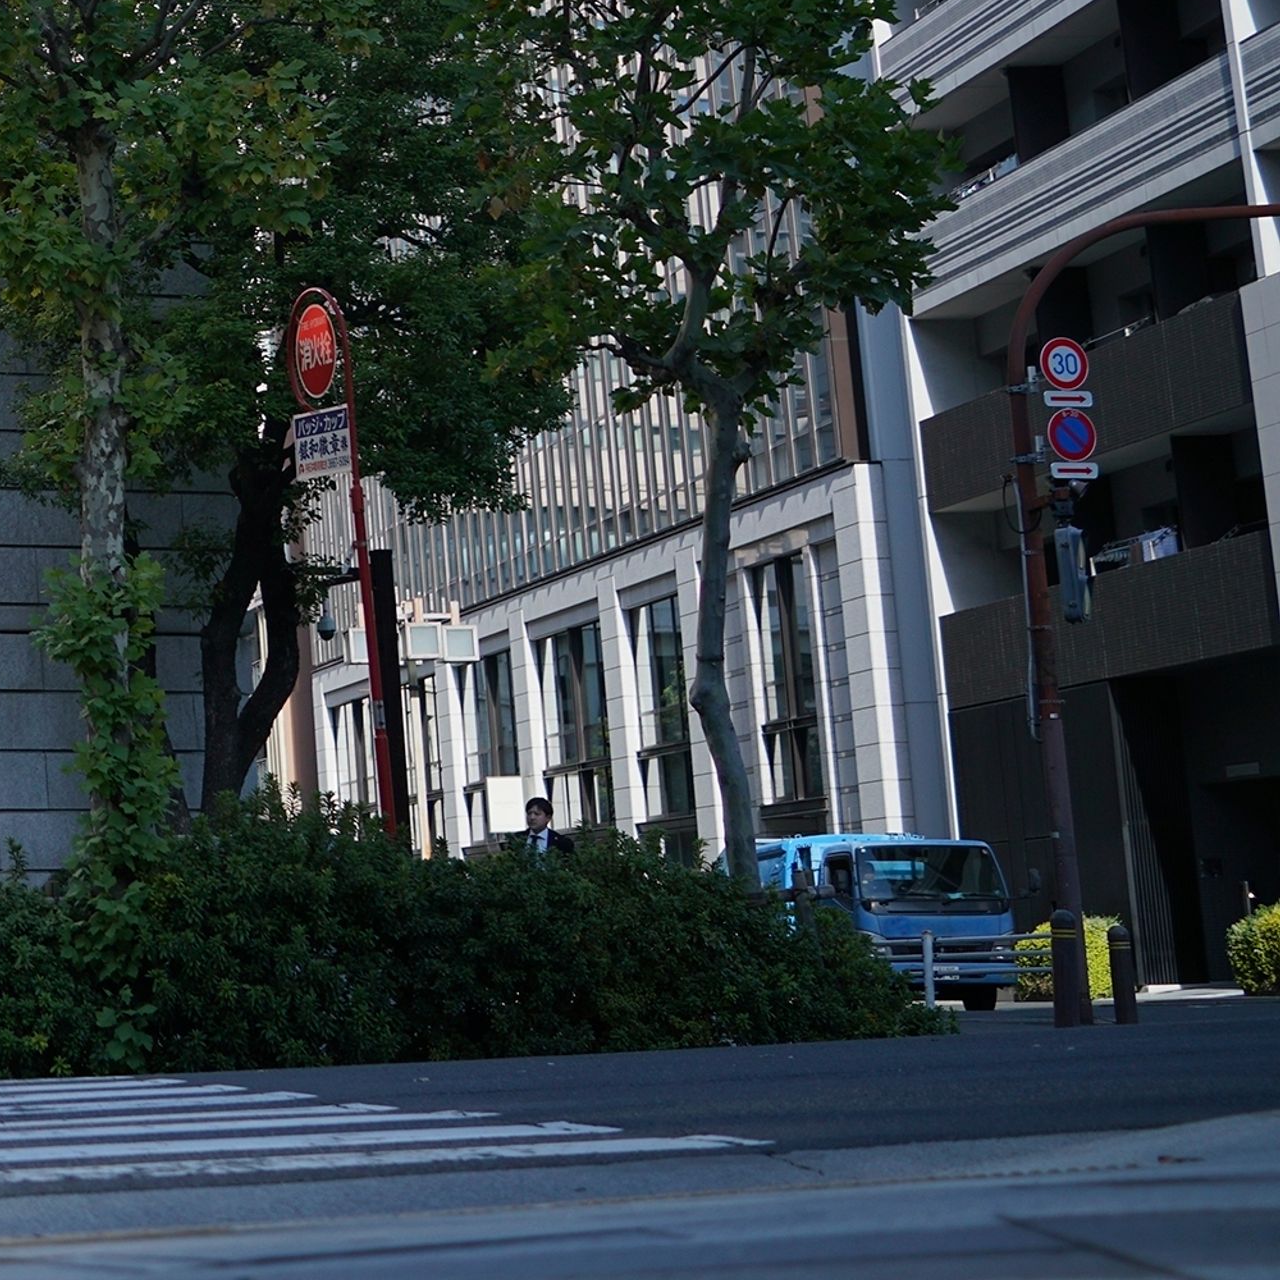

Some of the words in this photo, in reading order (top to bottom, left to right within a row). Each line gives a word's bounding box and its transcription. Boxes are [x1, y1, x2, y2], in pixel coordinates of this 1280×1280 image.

[299, 330, 333, 373] 消火栓
[1052, 353, 1078, 375] 30
